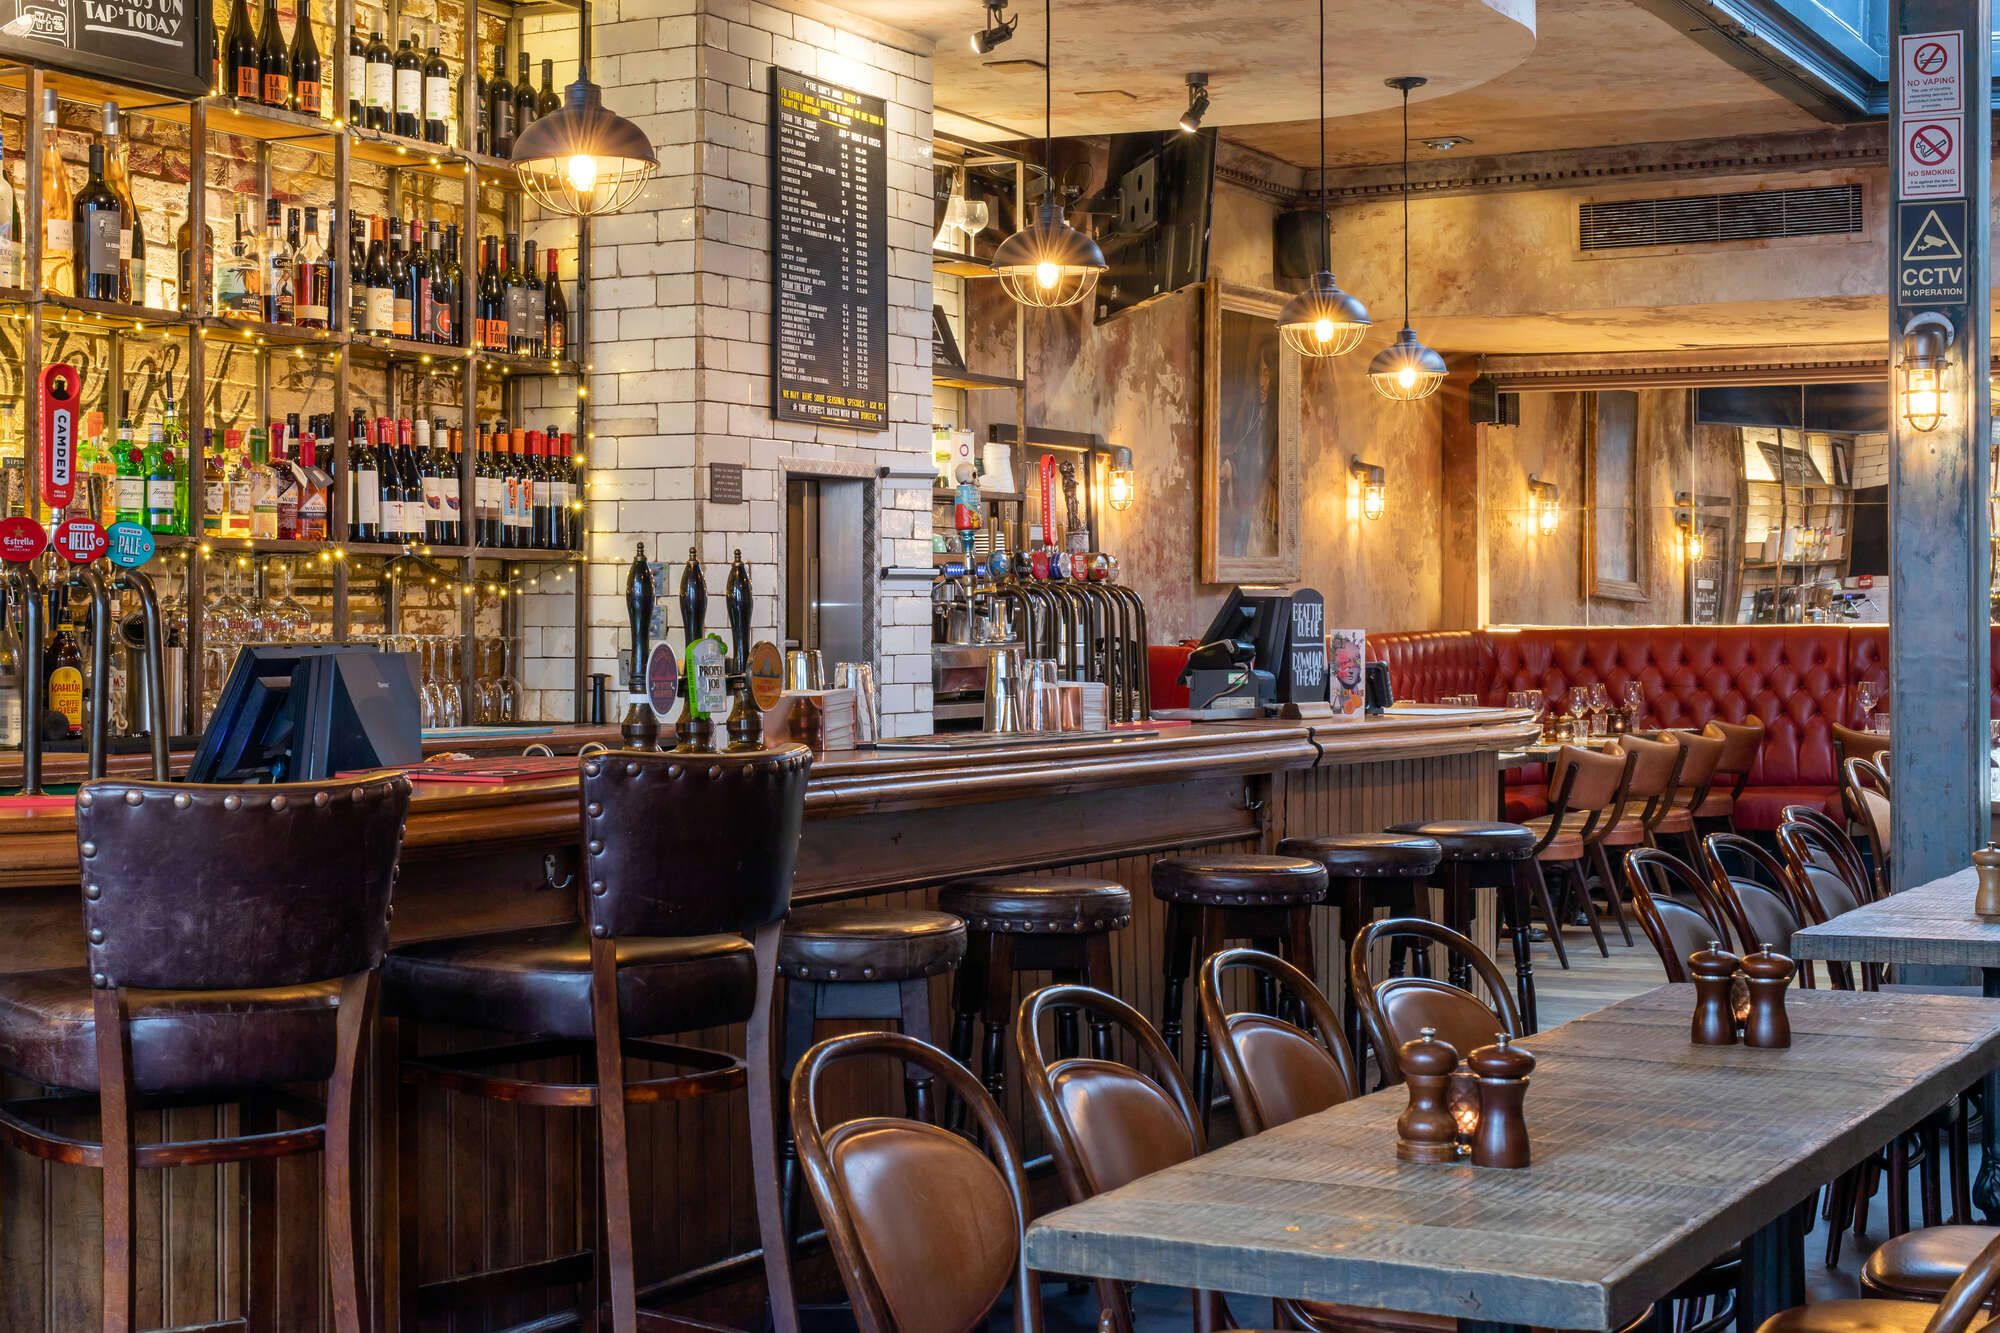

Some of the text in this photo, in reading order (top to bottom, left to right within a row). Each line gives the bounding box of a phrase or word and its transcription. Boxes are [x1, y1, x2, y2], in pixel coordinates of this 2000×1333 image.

[125, 9, 181, 36] TODAY
[269, 75, 279, 87] LA
[1922, 76, 1955, 85] VAPING
[303, 83, 312, 94] LA
[781, 146, 805, 158] DESPERADOS
[808, 163, 824, 172] ALCOHOL
[1920, 168, 1956, 176] SMOKING
[782, 253, 794, 261] LUCKY
[1902, 266, 1962, 286] CCTV
[1902, 287, 1963, 297] IN OPERATION
[490, 321, 499, 331] LA
[782, 336, 801, 345] ESTRELLA
[827, 396, 845, 407] SEASONAL
[847, 399, 864, 409] SPECIALS
[808, 405, 824, 415] PERFECT
[827, 408, 840, 417] MATCH
[56, 415, 67, 479] CAMDEN
[3, 536, 34, 546] Estrella
[68, 531, 95, 551] HELLS
[117, 535, 141, 555] PALE
[1293, 603, 1310, 622] BEAT
[1297, 619, 1320, 637] QUEUE
[1292, 651, 1323, 671] DOWNLOAD
[1296, 669, 1322, 686] THE APP
[708, 678, 720, 691] JOB
